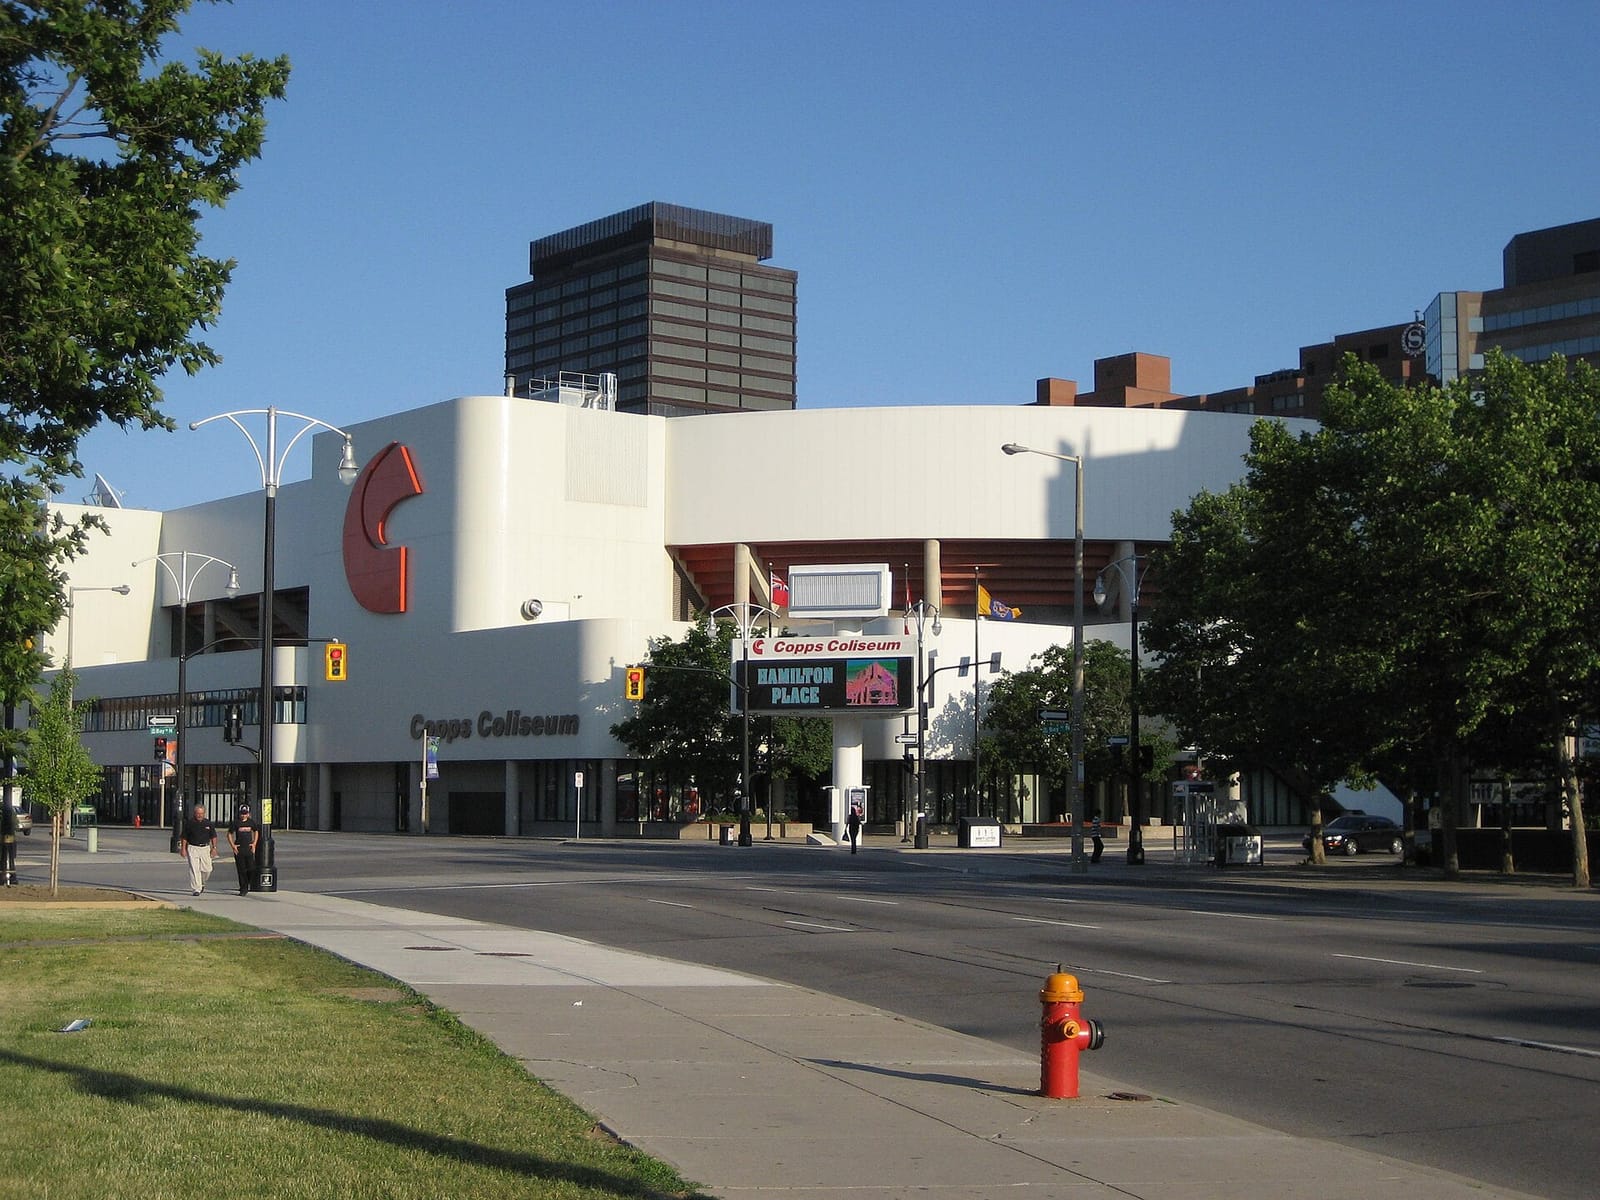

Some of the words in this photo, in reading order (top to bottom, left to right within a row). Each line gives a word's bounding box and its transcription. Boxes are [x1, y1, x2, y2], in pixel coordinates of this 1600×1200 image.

[773, 641, 824, 654] Copps
[827, 639, 901, 651] Coliseum
[757, 666, 834, 685] HAMILTON
[771, 686, 820, 704] PLACE
[410, 713, 473, 743] Copps
[477, 710, 580, 737] Coliseum
